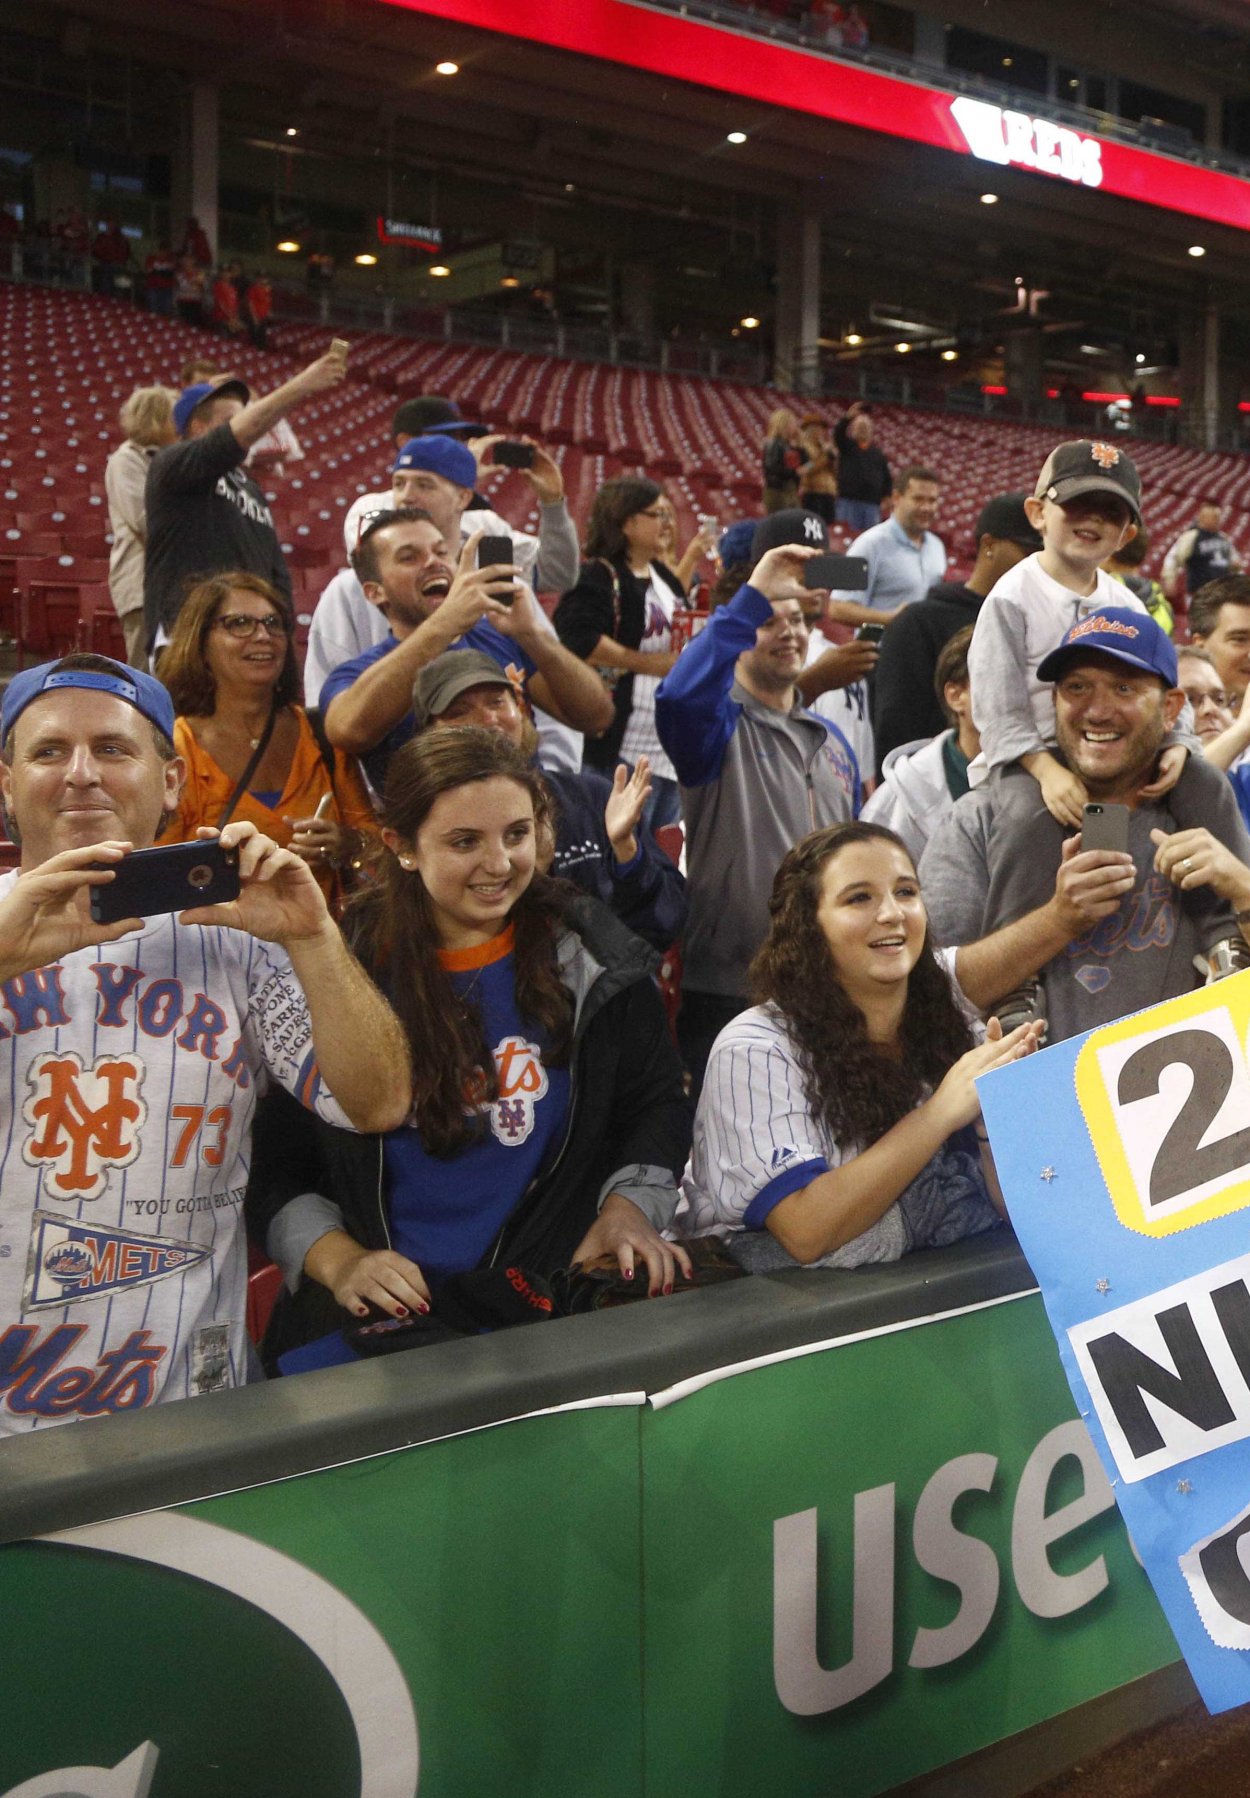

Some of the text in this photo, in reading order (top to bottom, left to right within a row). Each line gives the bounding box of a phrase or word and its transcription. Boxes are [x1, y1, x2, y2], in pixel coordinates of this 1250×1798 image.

[1066, 877, 1174, 957] ets
[264, 993, 307, 1042] PARKE
[461, 1042, 541, 1104] ets
[31, 1058, 142, 1191] NY
[169, 1103, 232, 1168] 73
[498, 1099, 526, 1137] NY
[80, 1237, 187, 1288] METS
[0, 1323, 168, 1417] Mets
[773, 1418, 1114, 1717] use
